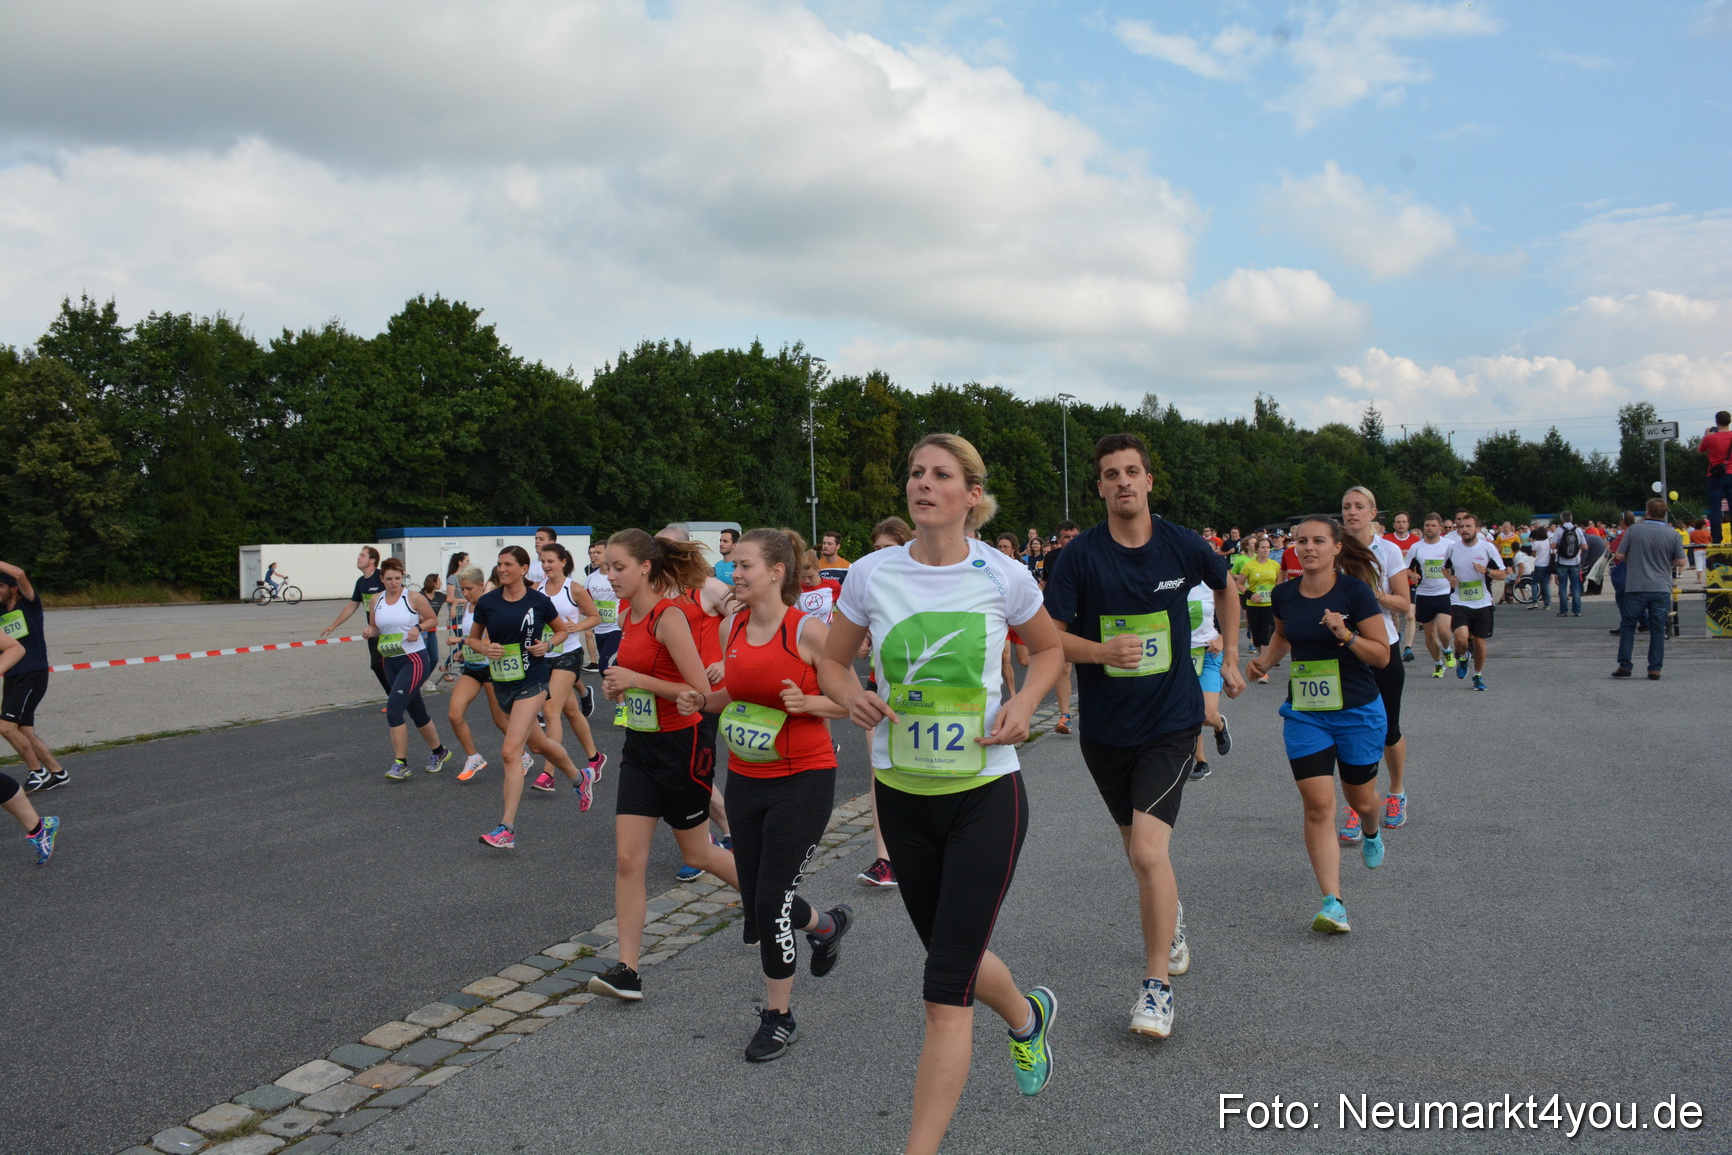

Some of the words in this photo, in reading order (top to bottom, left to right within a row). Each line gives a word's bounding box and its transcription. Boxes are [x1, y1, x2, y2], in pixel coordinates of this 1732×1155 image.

[1646, 428, 1659, 436] WC
[983, 566, 1006, 596] Bionorica
[1463, 588, 1479, 596] 404
[4, 621, 22, 635] 670
[380, 643, 401, 653] 1131
[491, 658, 519, 671] 1153
[1299, 680, 1330, 697] 706
[724, 723, 772, 751] 1372
[907, 721, 965, 751] 112
[914, 756, 934, 764] Annika
[774, 889, 796, 964] adidas
